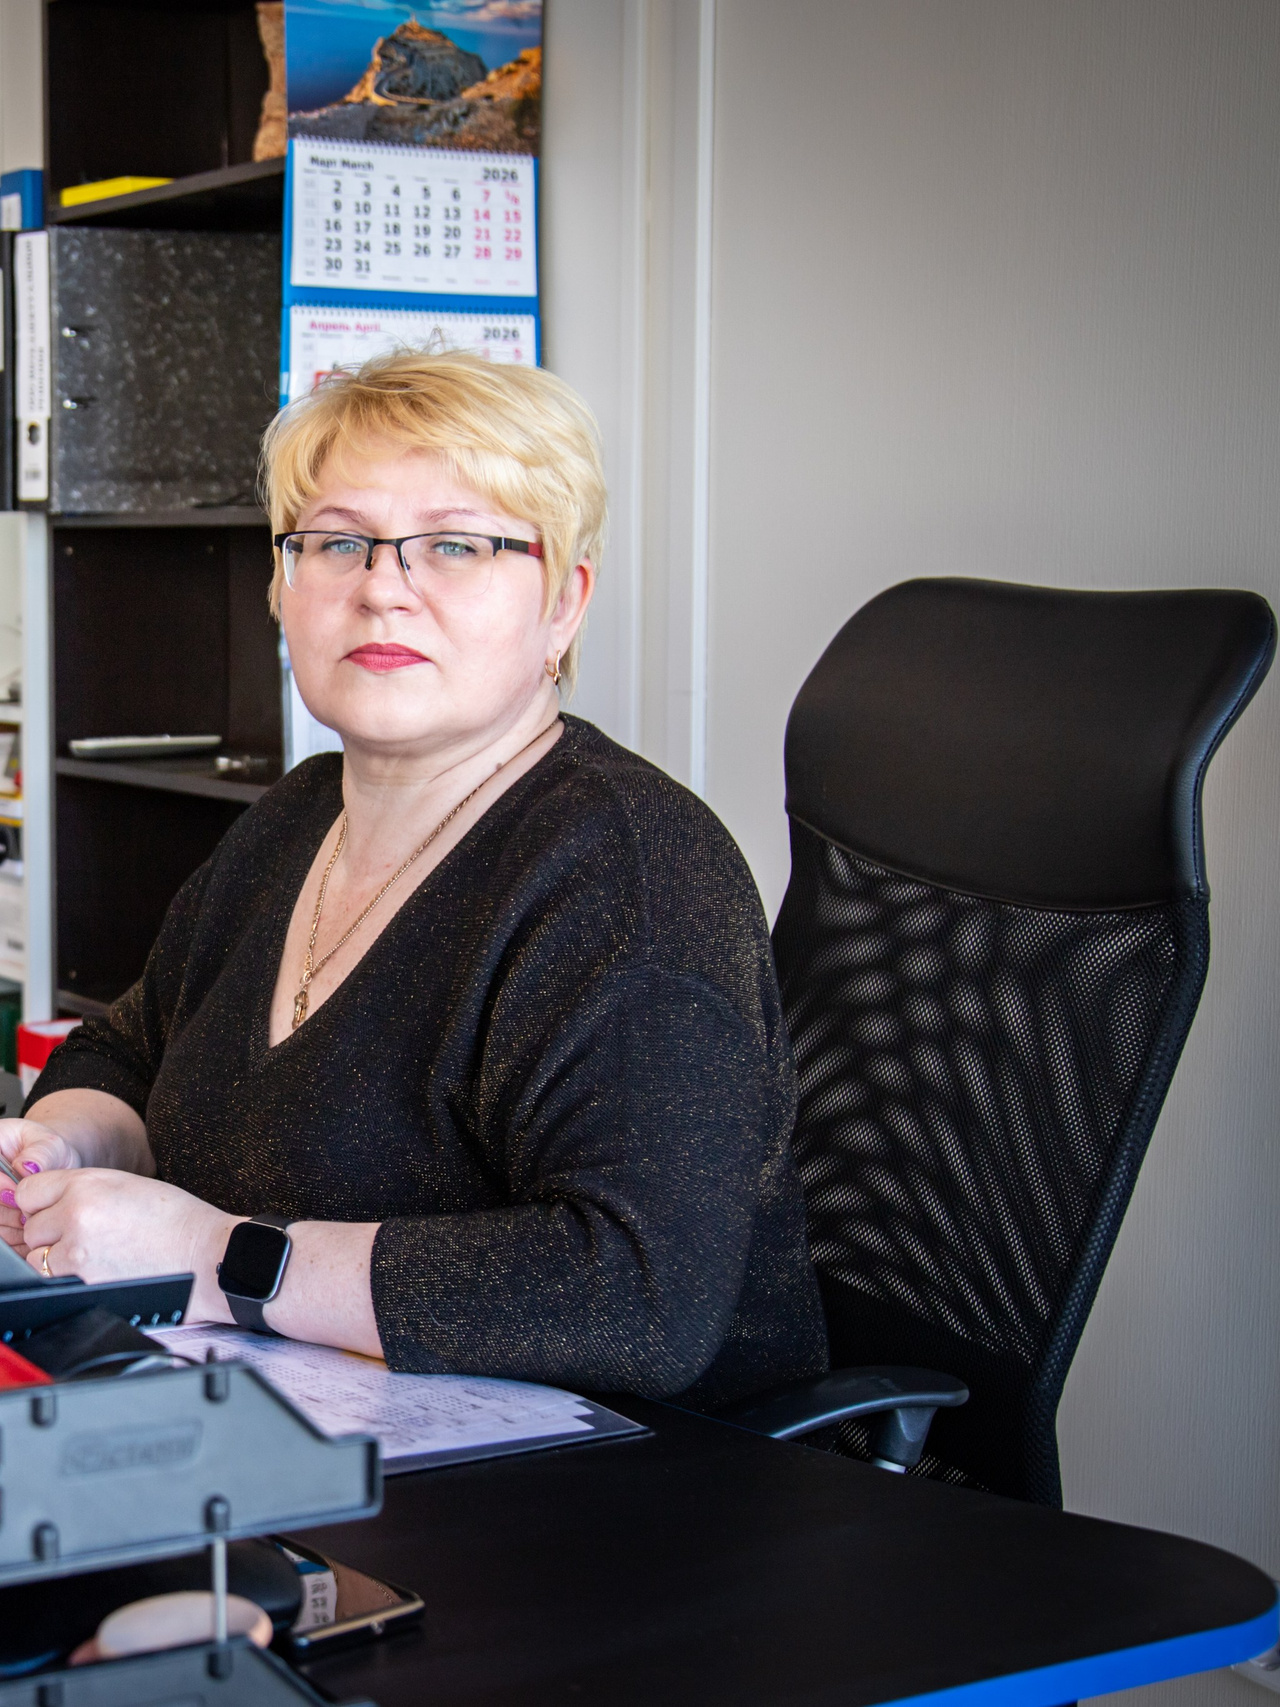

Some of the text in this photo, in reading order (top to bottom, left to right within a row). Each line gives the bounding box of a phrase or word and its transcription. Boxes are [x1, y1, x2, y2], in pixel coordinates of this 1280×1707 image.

[310, 156, 374, 171] Март March
[483, 167, 518, 181] 2026
[333, 179, 342, 194] 2
[363, 182, 371, 196] 3
[391, 184, 400, 198] 4
[422, 186, 431, 200] 5
[451, 188, 461, 201] 6
[333, 199, 521, 223] 9 10 11 12 13 14 15
[325, 218, 342, 232] 16
[355, 220, 371, 234] 17
[385, 223, 401, 236] 18
[414, 224, 431, 238] 19
[444, 226, 461, 239] 20
[475, 228, 490, 241] 21
[504, 229, 521, 242] 22
[325, 237, 342, 252] 23
[354, 240, 371, 253] 24
[384, 241, 401, 255] 25
[414, 244, 431, 257] 26
[444, 246, 461, 258] 27
[475, 247, 492, 260] 28
[505, 248, 522, 261] 29
[325, 257, 342, 271] 30
[355, 258, 370, 273] 31
[309, 321, 382, 333] Апрель April
[483, 327, 520, 340] 2026
